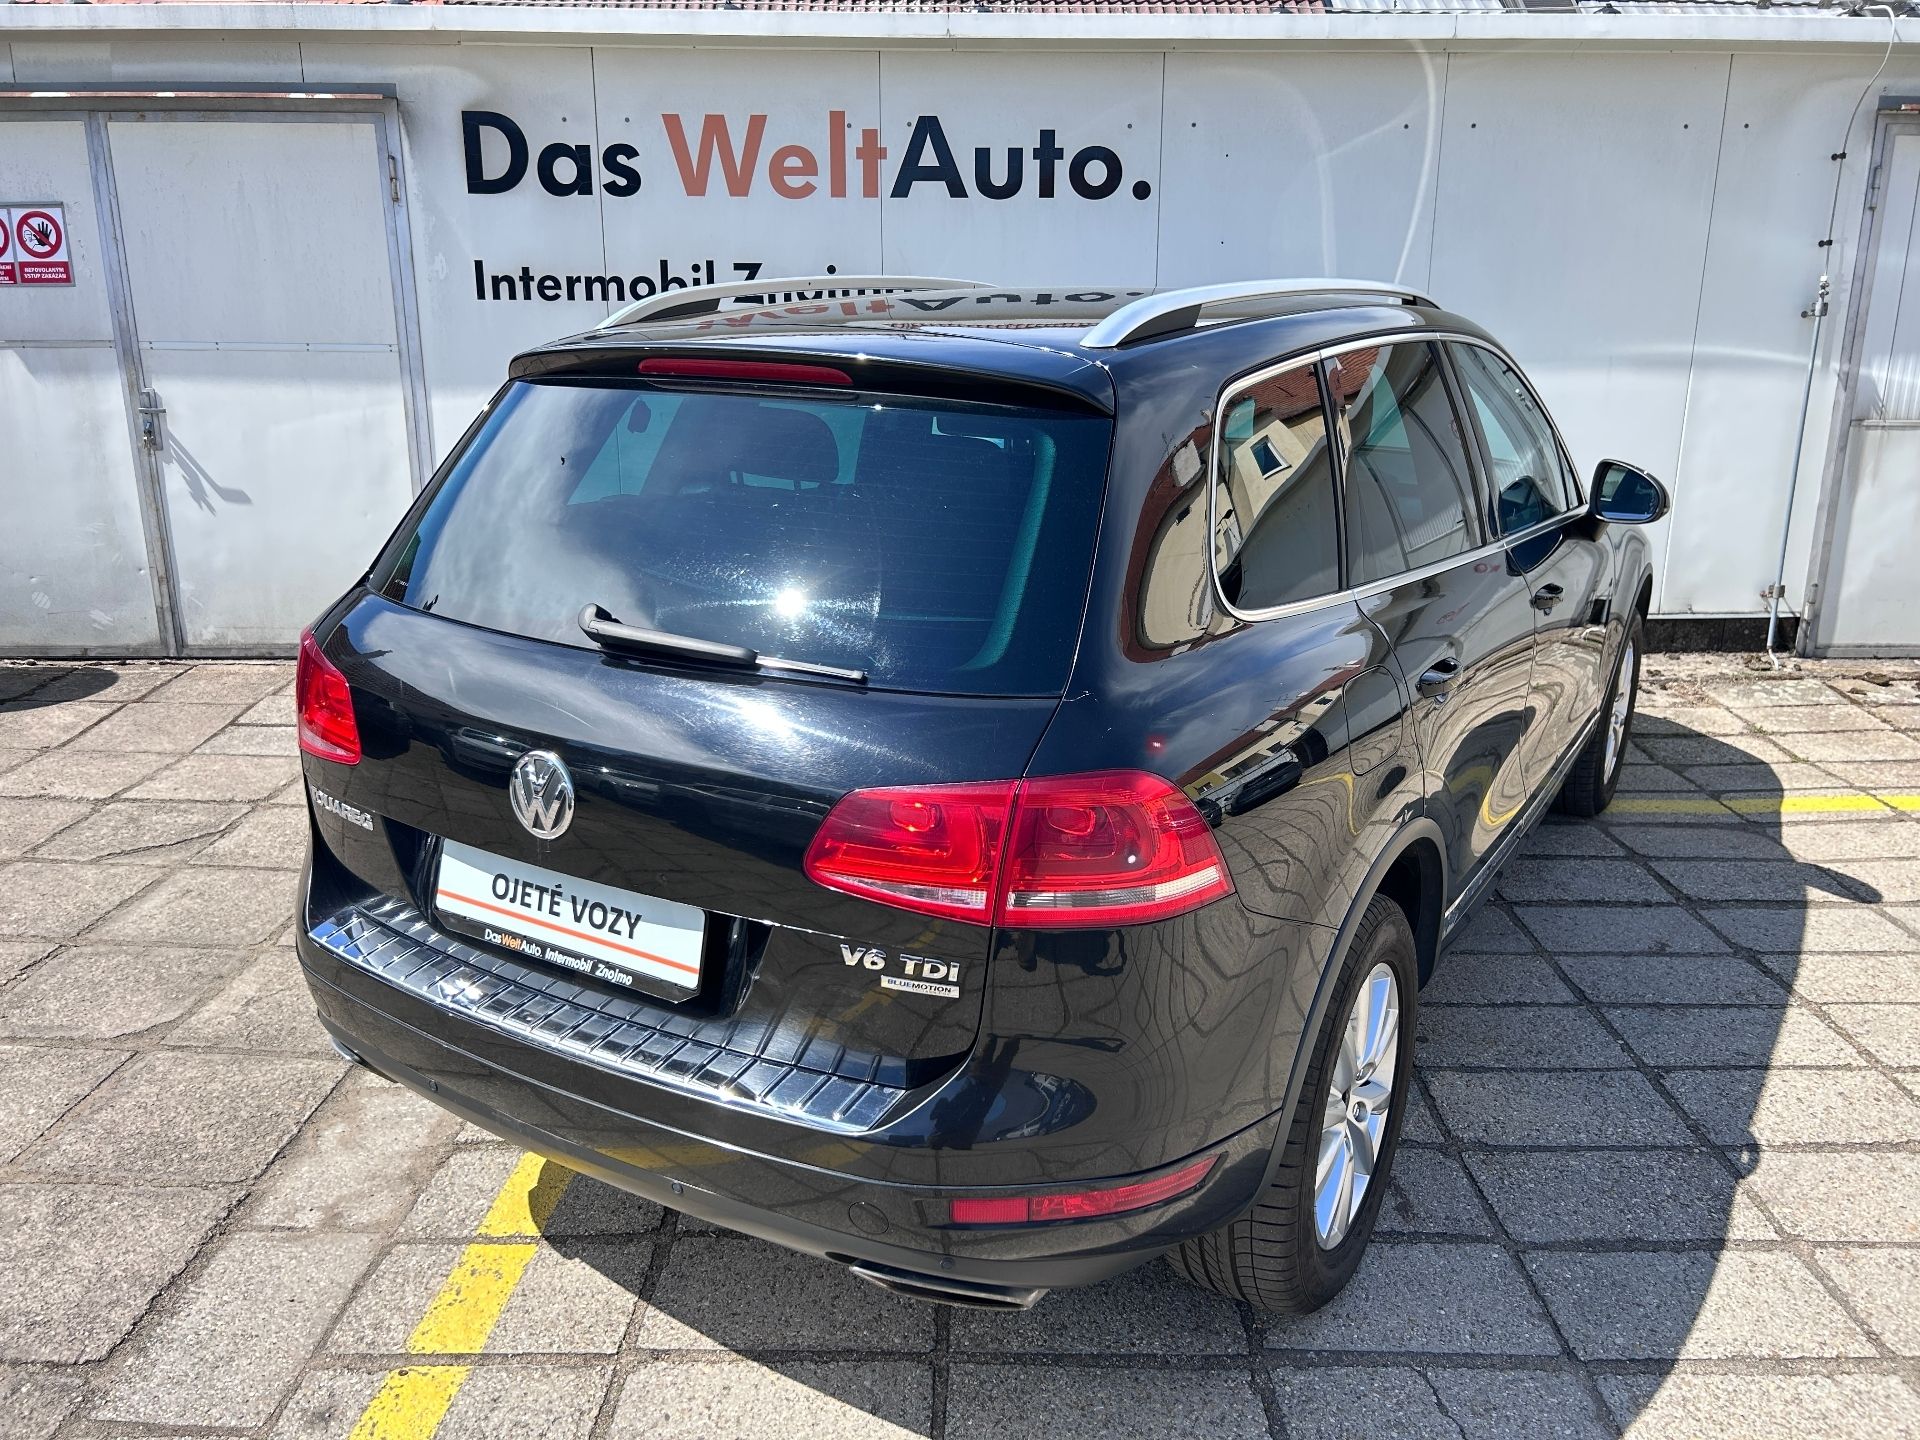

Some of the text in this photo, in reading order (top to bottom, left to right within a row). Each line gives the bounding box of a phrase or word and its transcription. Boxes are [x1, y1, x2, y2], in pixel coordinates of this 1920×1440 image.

[461, 110, 1152, 200] Das WeltAuto.
[474, 259, 715, 302] Intermobil
[492, 873, 643, 940] OJETÉ VOZY
[544, 946, 598, 974] Intermobil
[595, 963, 633, 986] Znojmo
[840, 943, 960, 982] V6 TDI
[887, 978, 952, 994] BLUEMOTION
